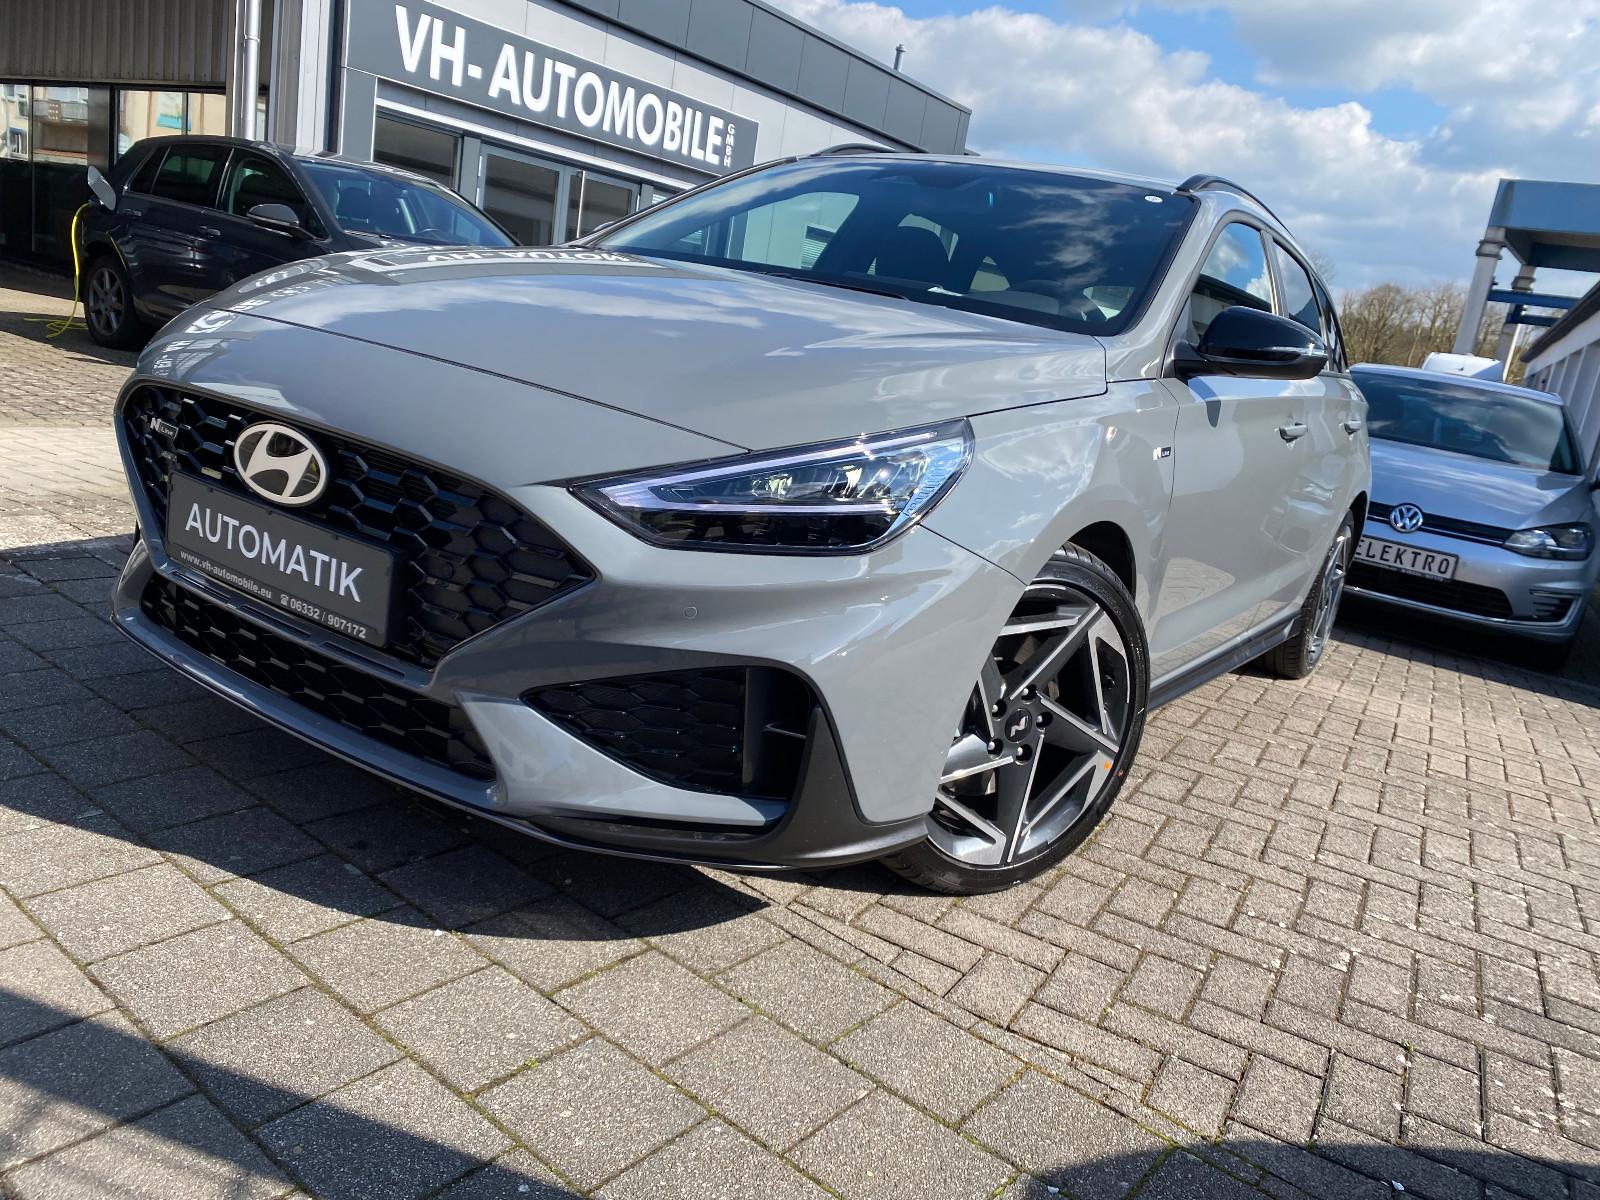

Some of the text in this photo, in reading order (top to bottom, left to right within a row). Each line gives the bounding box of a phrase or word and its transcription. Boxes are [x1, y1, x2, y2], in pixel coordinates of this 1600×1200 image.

[395, 4, 724, 165] VH- AUTOMOBILE
[180, 551, 272, 599] www.vh-automobile.eu
[290, 598, 321, 620] 06332
[327, 614, 367, 639] 907172
[185, 503, 363, 603] AUTOMATIK
